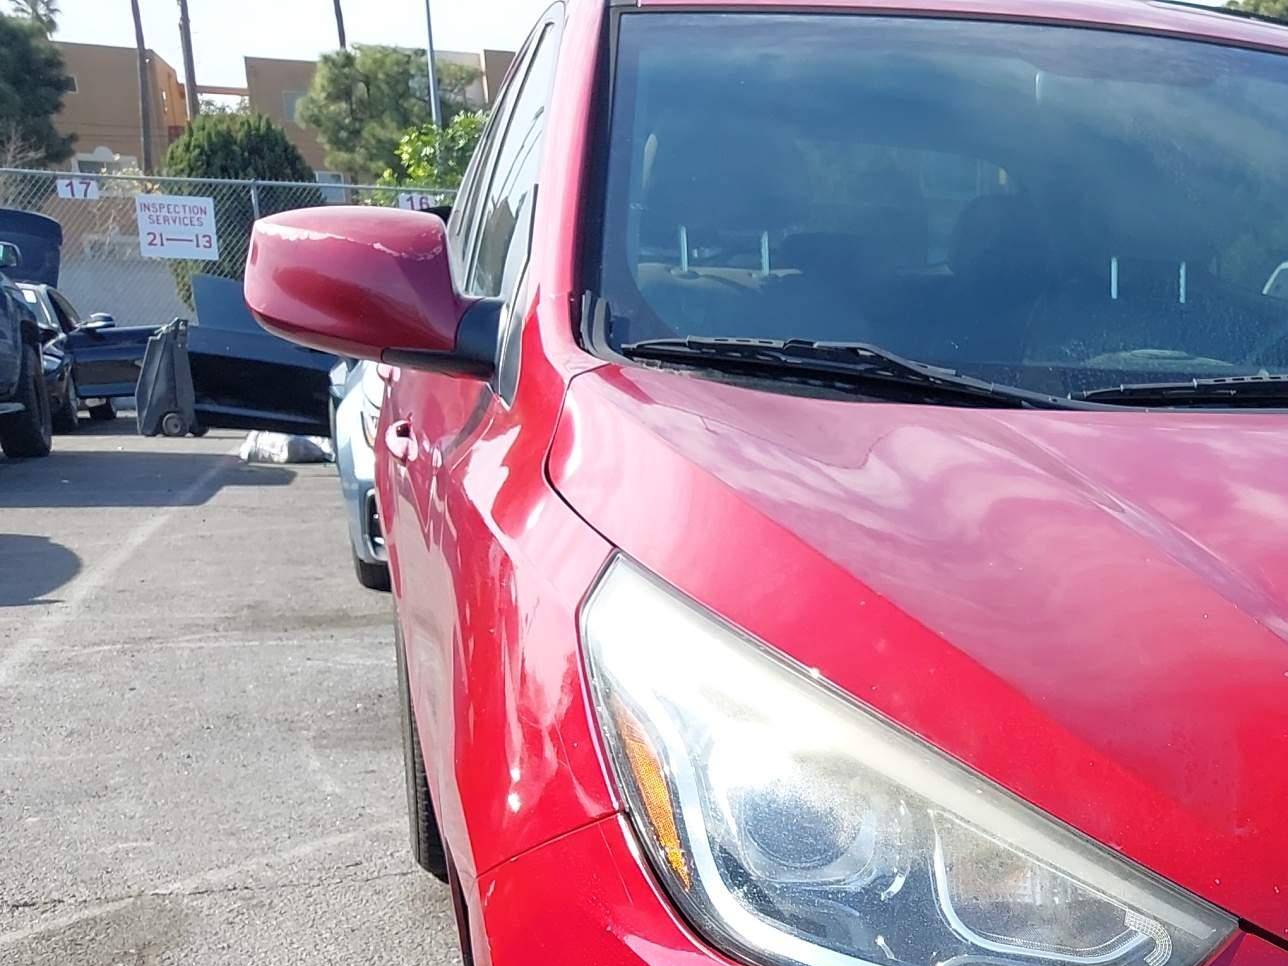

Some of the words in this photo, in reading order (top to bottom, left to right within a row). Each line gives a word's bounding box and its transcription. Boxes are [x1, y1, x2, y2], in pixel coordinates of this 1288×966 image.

[65, 180, 92, 198] 17
[139, 203, 208, 216] INSPECTION
[406, 195, 430, 210] 16
[148, 216, 204, 227] SERVICES
